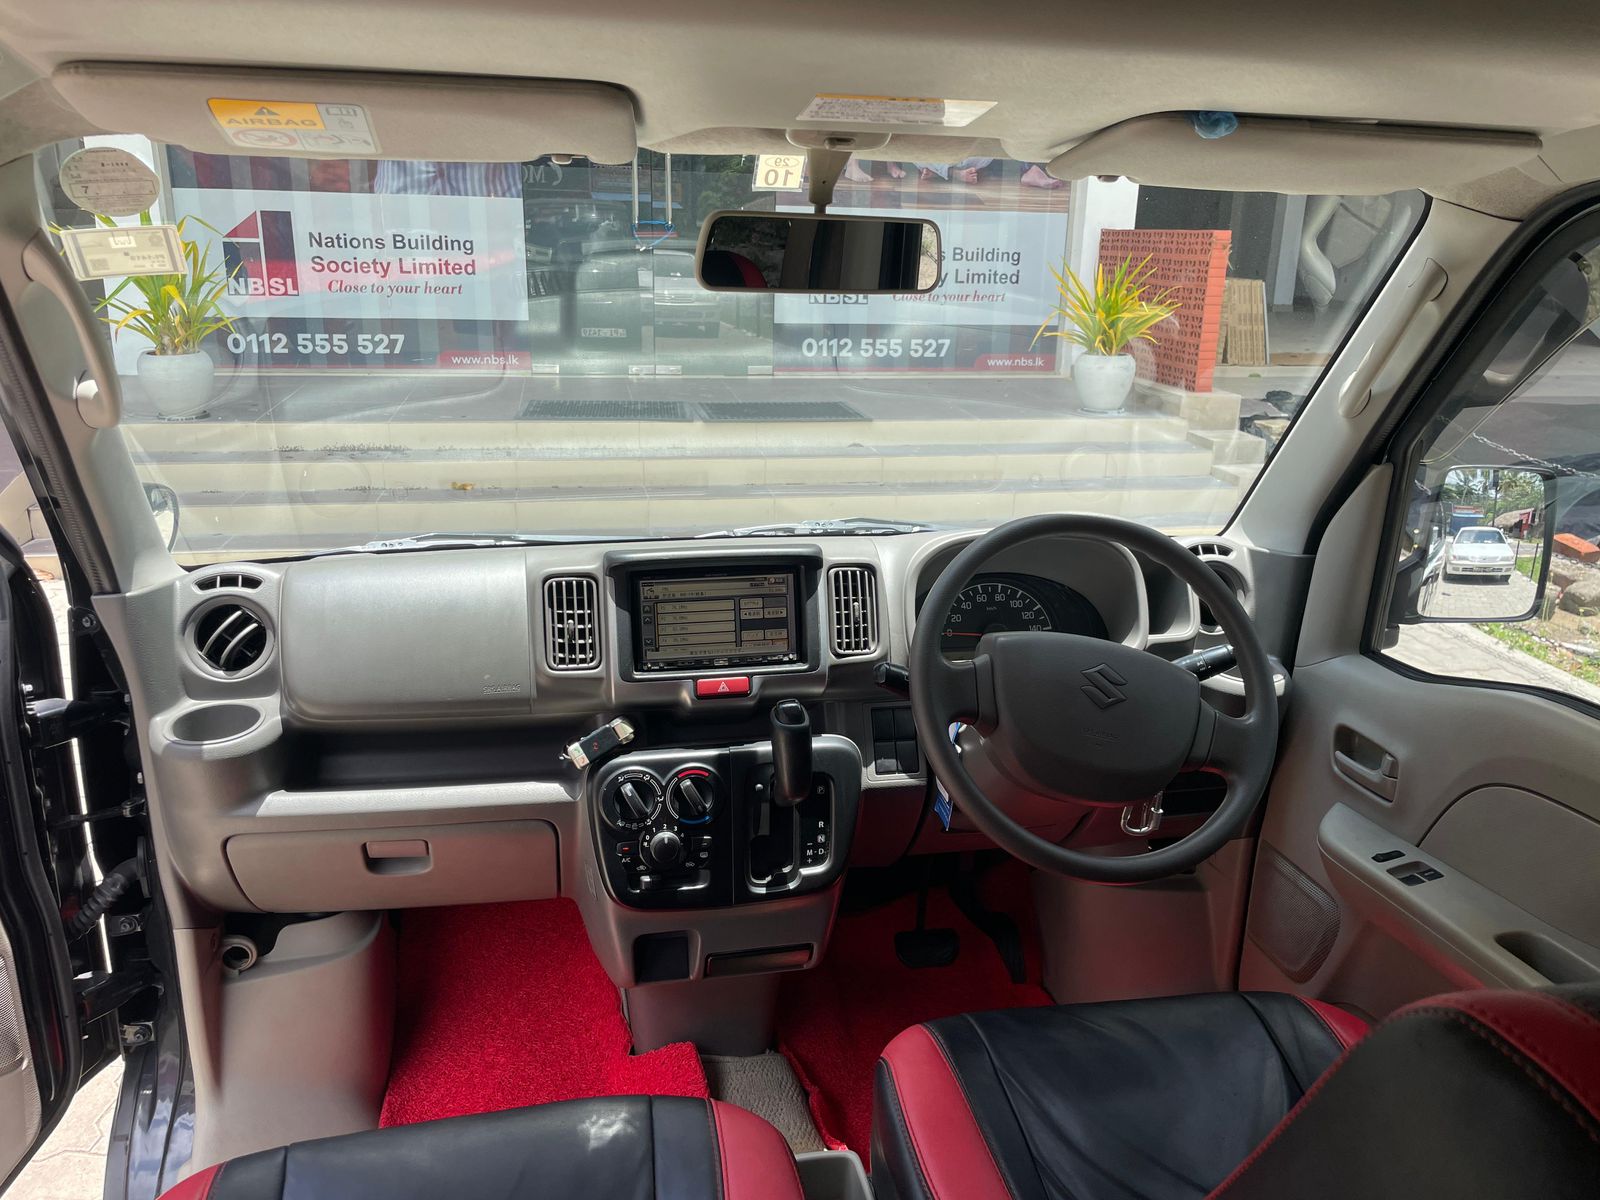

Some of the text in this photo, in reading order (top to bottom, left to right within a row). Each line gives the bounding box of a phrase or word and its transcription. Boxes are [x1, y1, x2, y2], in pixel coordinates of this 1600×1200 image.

[226, 118, 318, 127] AIRBAG
[308, 232, 474, 255] Nations Building
[952, 247, 1021, 266] Building
[311, 255, 476, 278] Society Limited
[954, 269, 1020, 285] Limited
[227, 276, 300, 296] NBSL
[328, 279, 463, 298] Close to your heart
[940, 293, 971, 305] your
[973, 290, 1006, 302] heart
[227, 332, 405, 355] 0112 555 527
[802, 337, 951, 358] 0112 555 527
[451, 354, 520, 365] www.nbs.lk
[987, 357, 1044, 367] www.nbs.lk
[976, 594, 987, 602] 60
[1010, 600, 1023, 608] 100
[961, 602, 972, 610] 40
[951, 614, 962, 622] 20
[1021, 611, 1034, 619] 120
